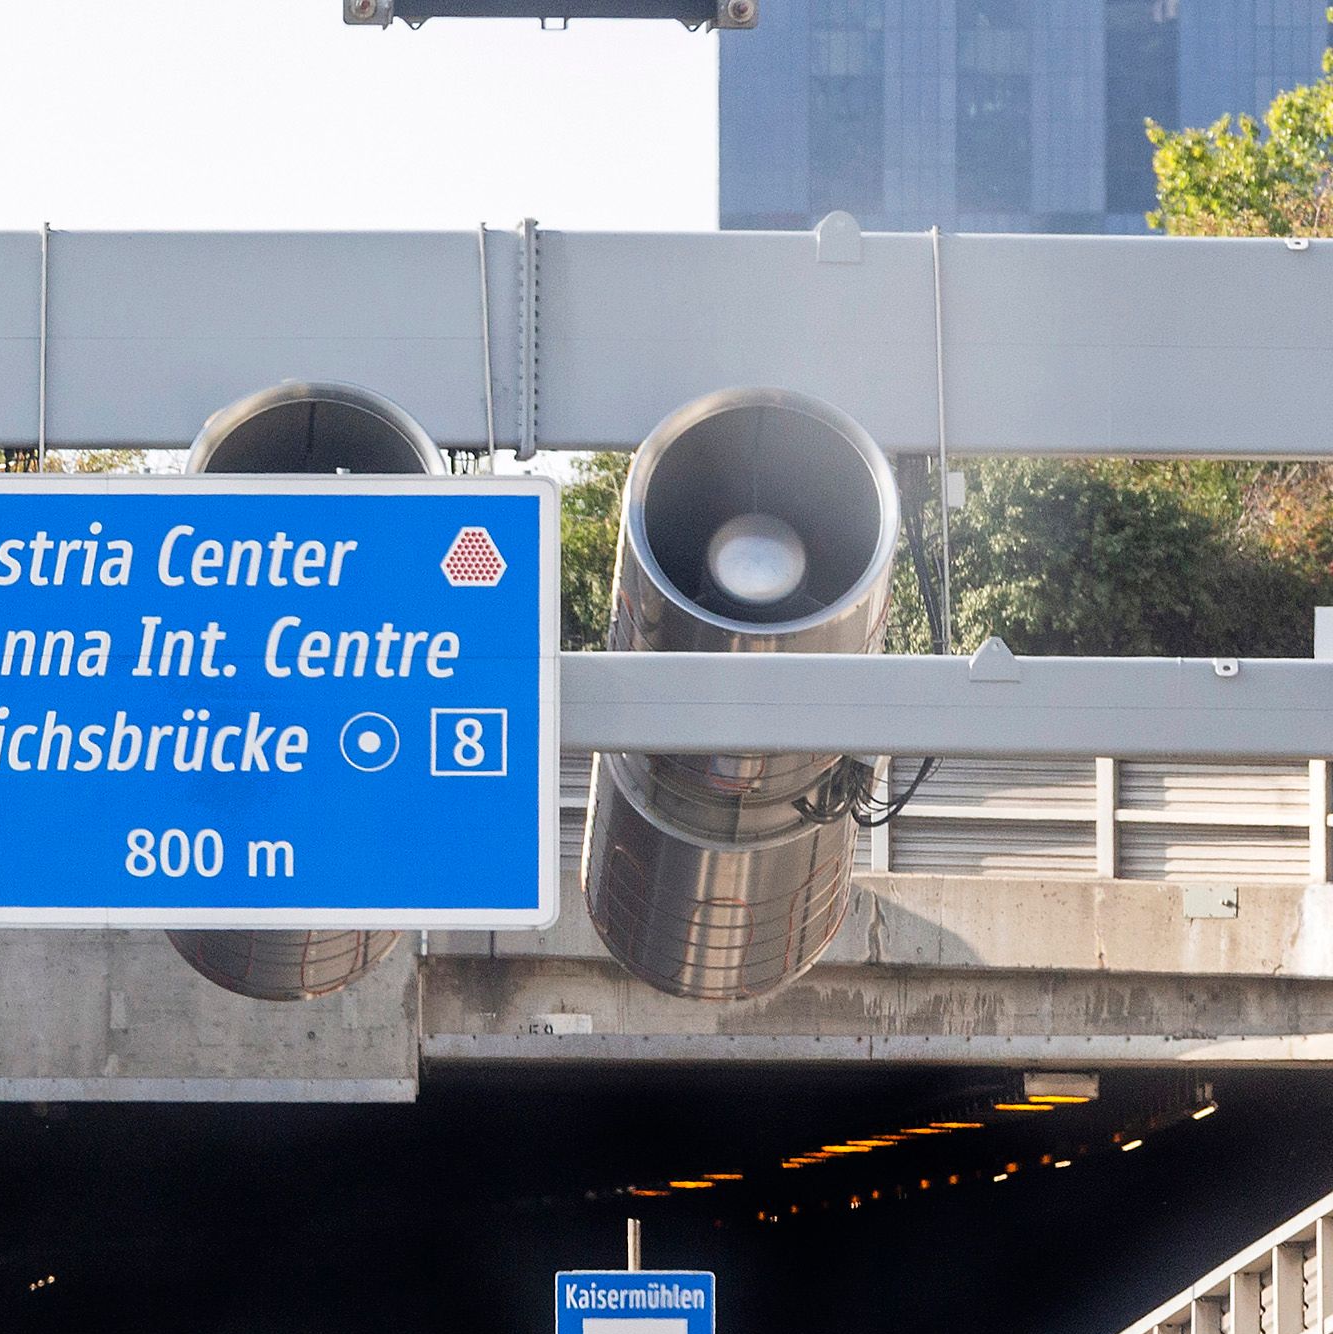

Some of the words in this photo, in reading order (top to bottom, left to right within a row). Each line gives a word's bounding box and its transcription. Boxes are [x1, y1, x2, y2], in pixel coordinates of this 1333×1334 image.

[157, 524, 358, 587] Center
[131, 615, 237, 678] Int.
[264, 615, 460, 679] Centre
[453, 712, 485, 767] 8
[125, 828, 224, 878] 800
[248, 840, 294, 877] m
[565, 1281, 705, 1310] Kaisermühlen
